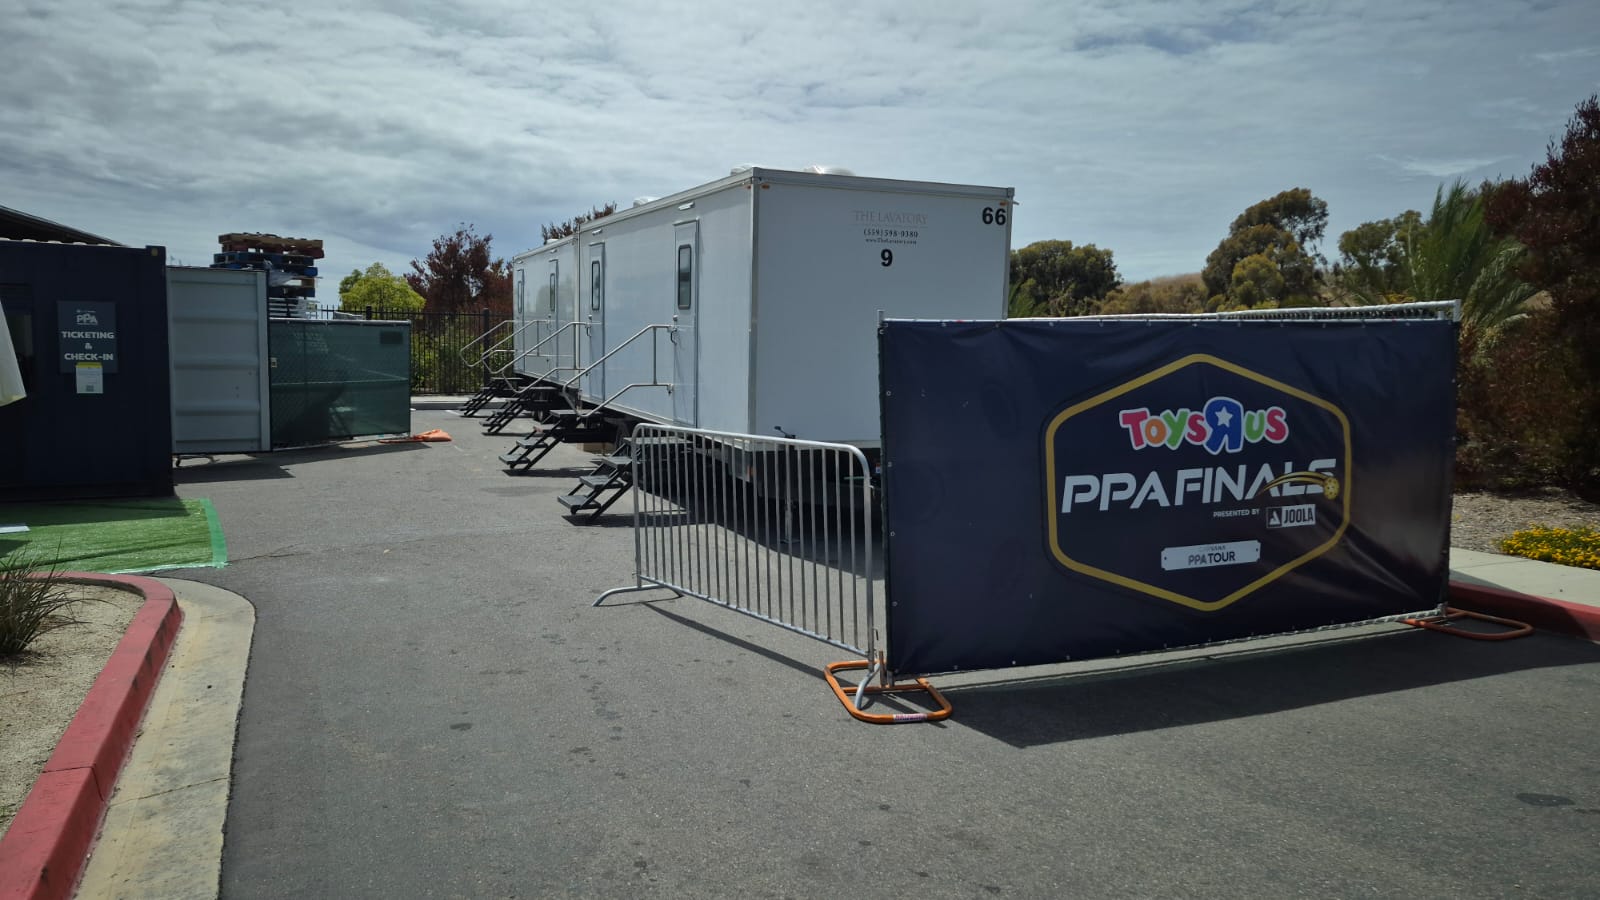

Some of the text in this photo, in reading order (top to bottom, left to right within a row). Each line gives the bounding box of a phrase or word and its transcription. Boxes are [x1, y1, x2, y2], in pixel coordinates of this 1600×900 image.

[854, 211, 877, 223] THE
[982, 207, 1007, 225] 66
[880, 248, 893, 267] 9
[61, 331, 115, 339] TICKETING
[85, 342, 93, 350] &
[64, 353, 114, 361] CHECK-IN
[1213, 509, 1250, 518] PRESENTED
[1284, 507, 1314, 524] JOOLA
[1188, 551, 1236, 565] PPA TOUR
